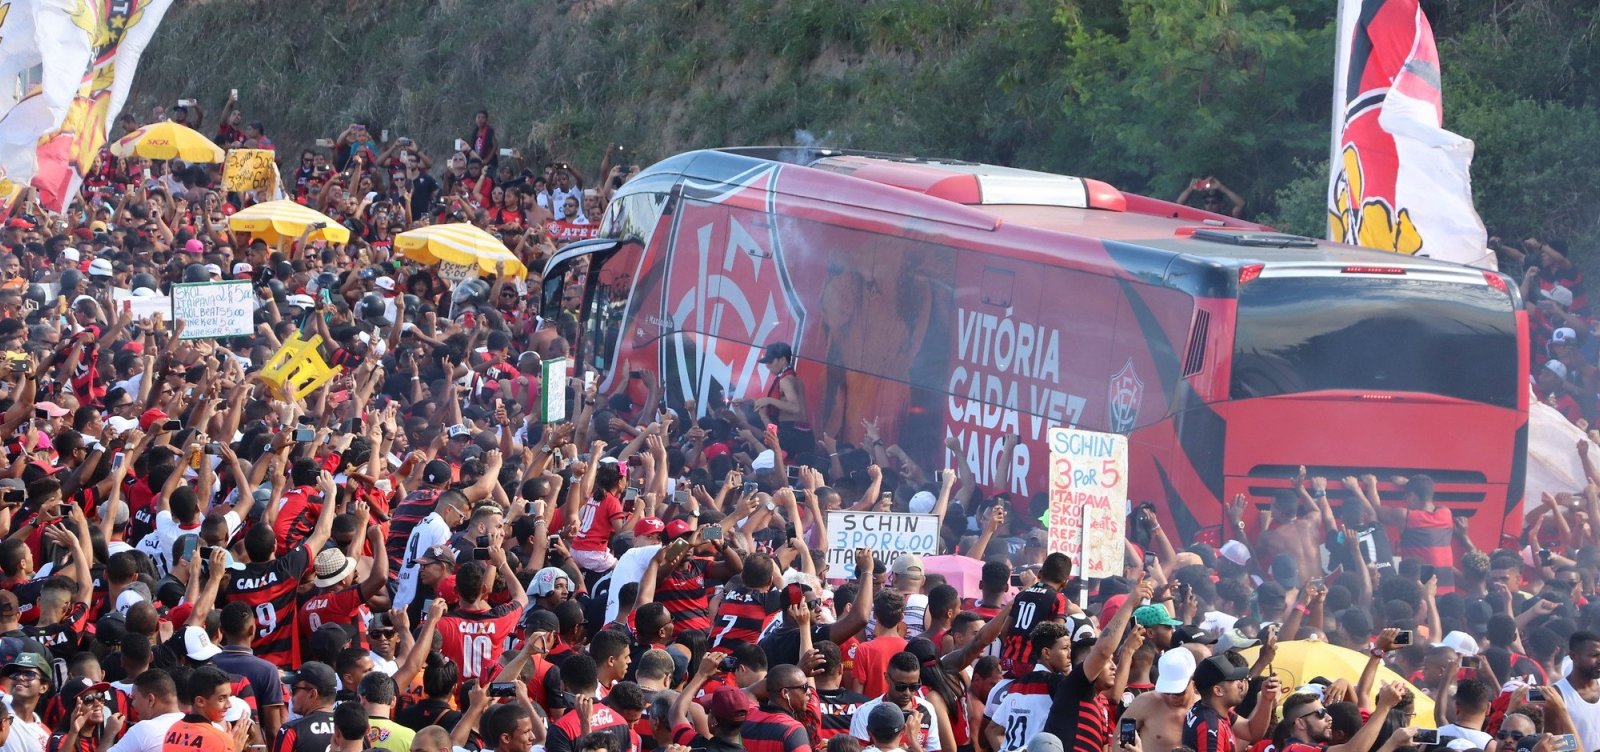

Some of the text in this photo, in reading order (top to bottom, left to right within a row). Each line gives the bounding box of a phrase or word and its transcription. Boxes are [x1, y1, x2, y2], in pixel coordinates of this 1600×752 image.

[958, 306, 1060, 384] VITÓRIA
[948, 366, 1020, 436] CADA
[1055, 432, 1115, 457] SCHIN
[944, 424, 1031, 497] MAIOR
[1054, 458, 1073, 490] 3
[1100, 460, 1120, 489] 5
[843, 514, 919, 533] SCHIN
[1051, 502, 1084, 518] SKO
[836, 531, 849, 549] 3
[852, 531, 893, 550] POR
[236, 571, 278, 590] CAIXA
[255, 602, 277, 638] 9
[459, 621, 496, 635] CAIXA
[1014, 601, 1037, 630] 10
[712, 614, 738, 648] 7
[463, 635, 493, 678] 10
[820, 703, 857, 716] AIXA
[310, 722, 335, 735] CAI
[1005, 714, 1028, 751] 10
